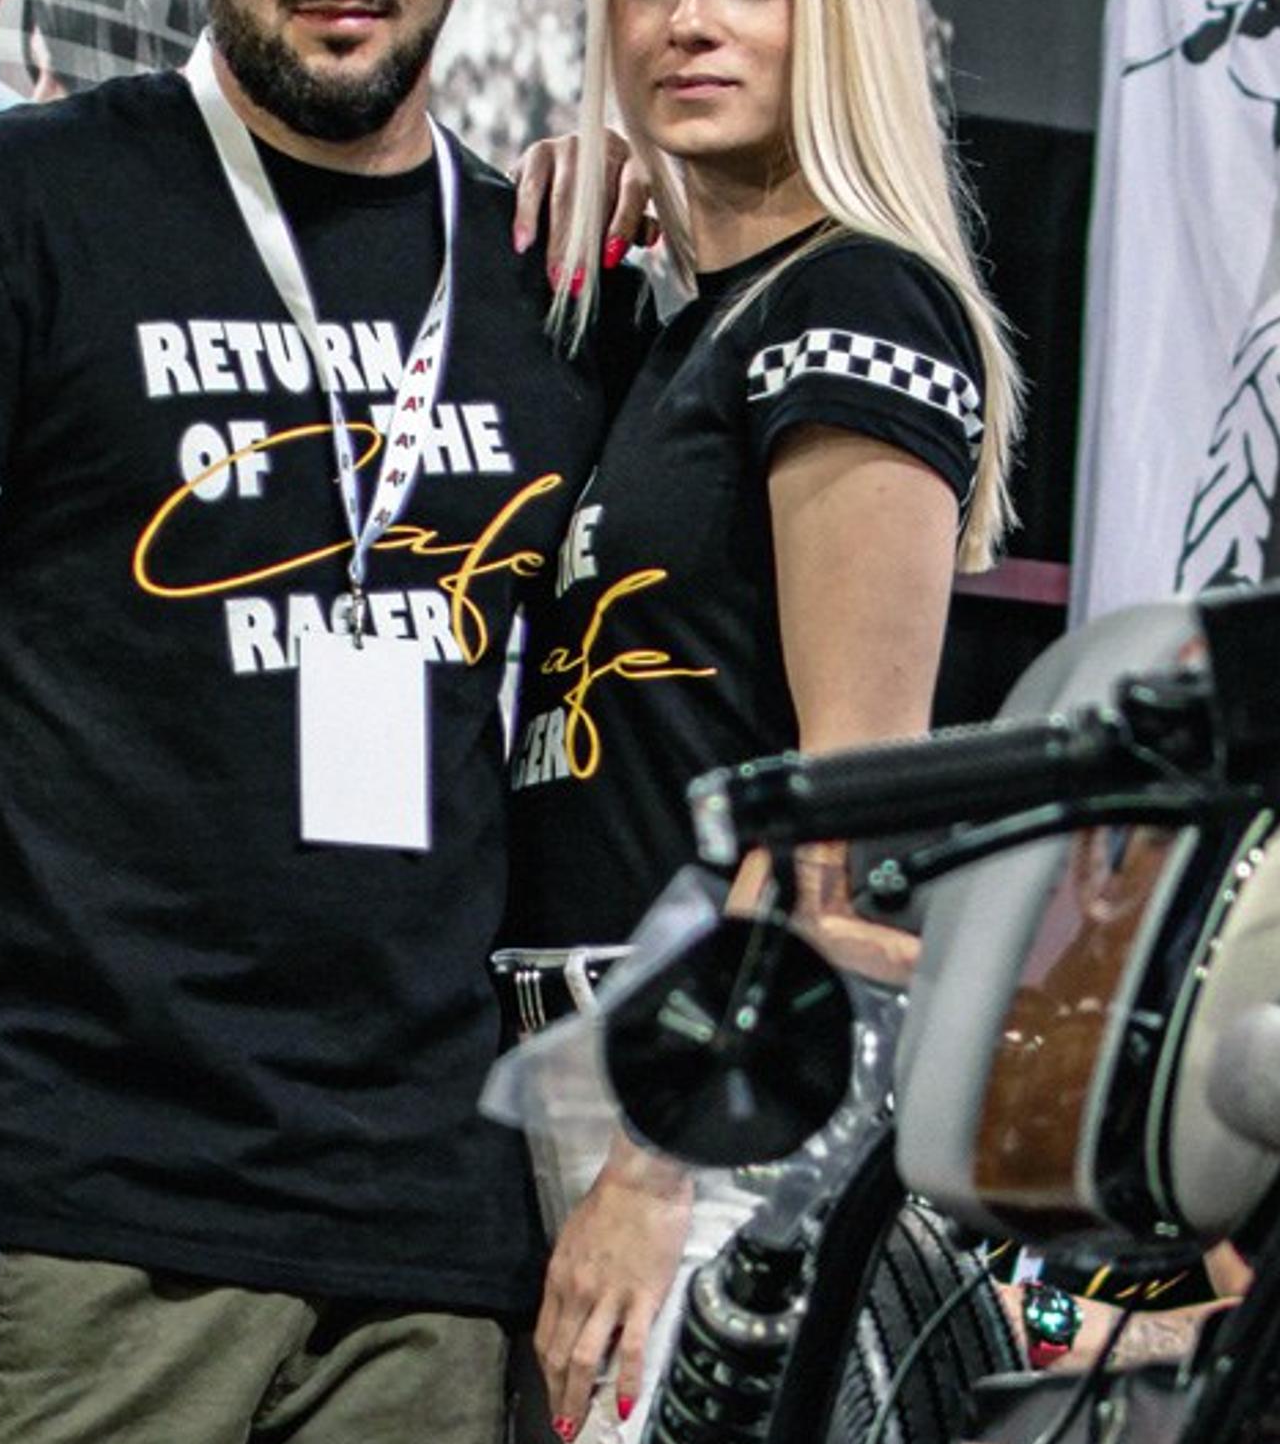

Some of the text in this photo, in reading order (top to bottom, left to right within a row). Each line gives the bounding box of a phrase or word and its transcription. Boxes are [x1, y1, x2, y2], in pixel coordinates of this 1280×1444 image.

[136, 319, 404, 398] RETURN
[179, 418, 273, 502] OF
[134, 421, 563, 665] Cafe
[541, 568, 718, 779] afe
